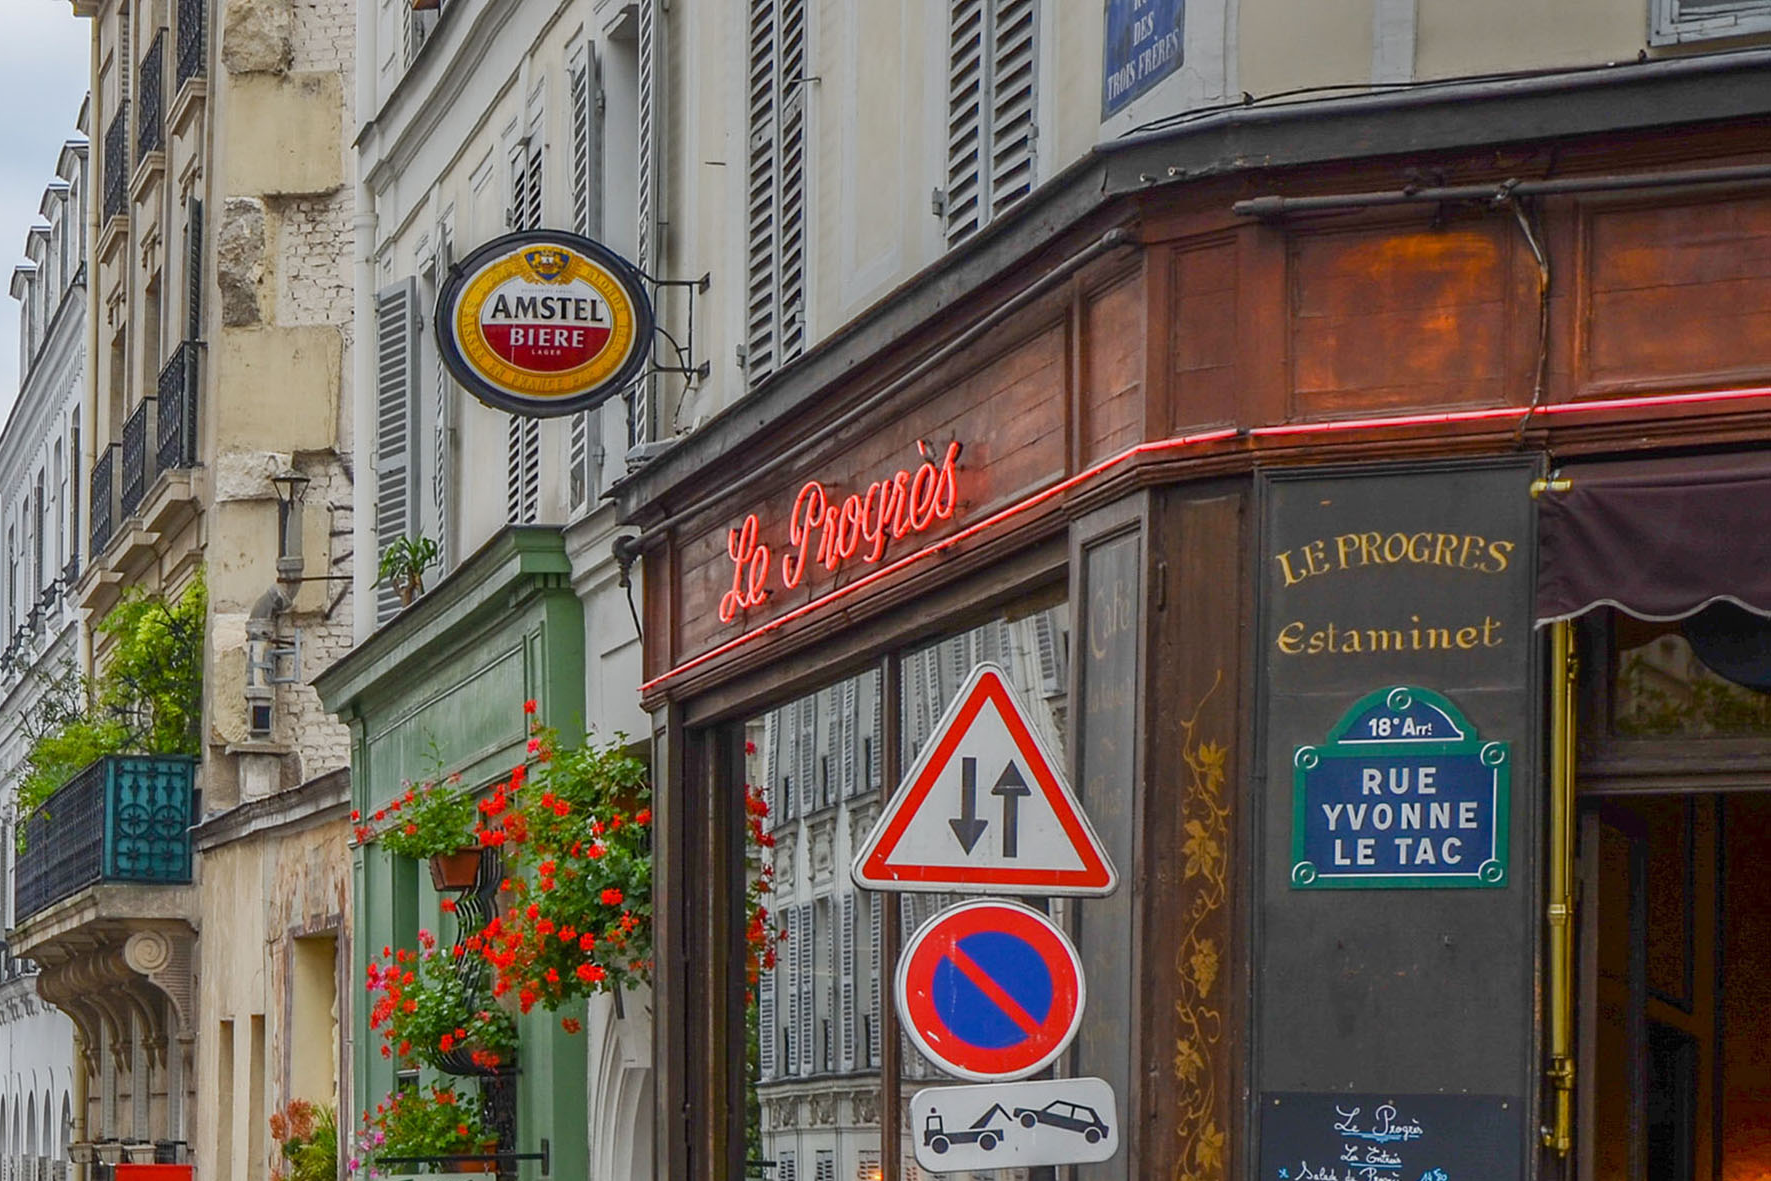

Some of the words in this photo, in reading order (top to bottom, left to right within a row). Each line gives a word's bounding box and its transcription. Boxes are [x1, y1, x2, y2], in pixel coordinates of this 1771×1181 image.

[1134, 11, 1154, 47] DES
[1108, 60, 1136, 100] TROIS
[1139, 28, 1179, 80] FRÈRES
[490, 294, 604, 323] AMSTEL
[509, 328, 585, 349] BIERE
[532, 348, 561, 356] LAGER
[719, 514, 770, 623] Le
[782, 440, 962, 590] Progrès
[1276, 540, 1331, 588] LE
[1334, 531, 1515, 574] PROGRES
[1276, 615, 1504, 655] Estaminet
[1362, 767, 1436, 795] RUE
[1322, 802, 1478, 831] YVONNE
[1334, 838, 1375, 865] LE
[1394, 837, 1462, 865] TAC
[1334, 1105, 1360, 1132] Le
[1372, 1105, 1423, 1141] Progrès
[1295, 1161, 1338, 1181] Salade
